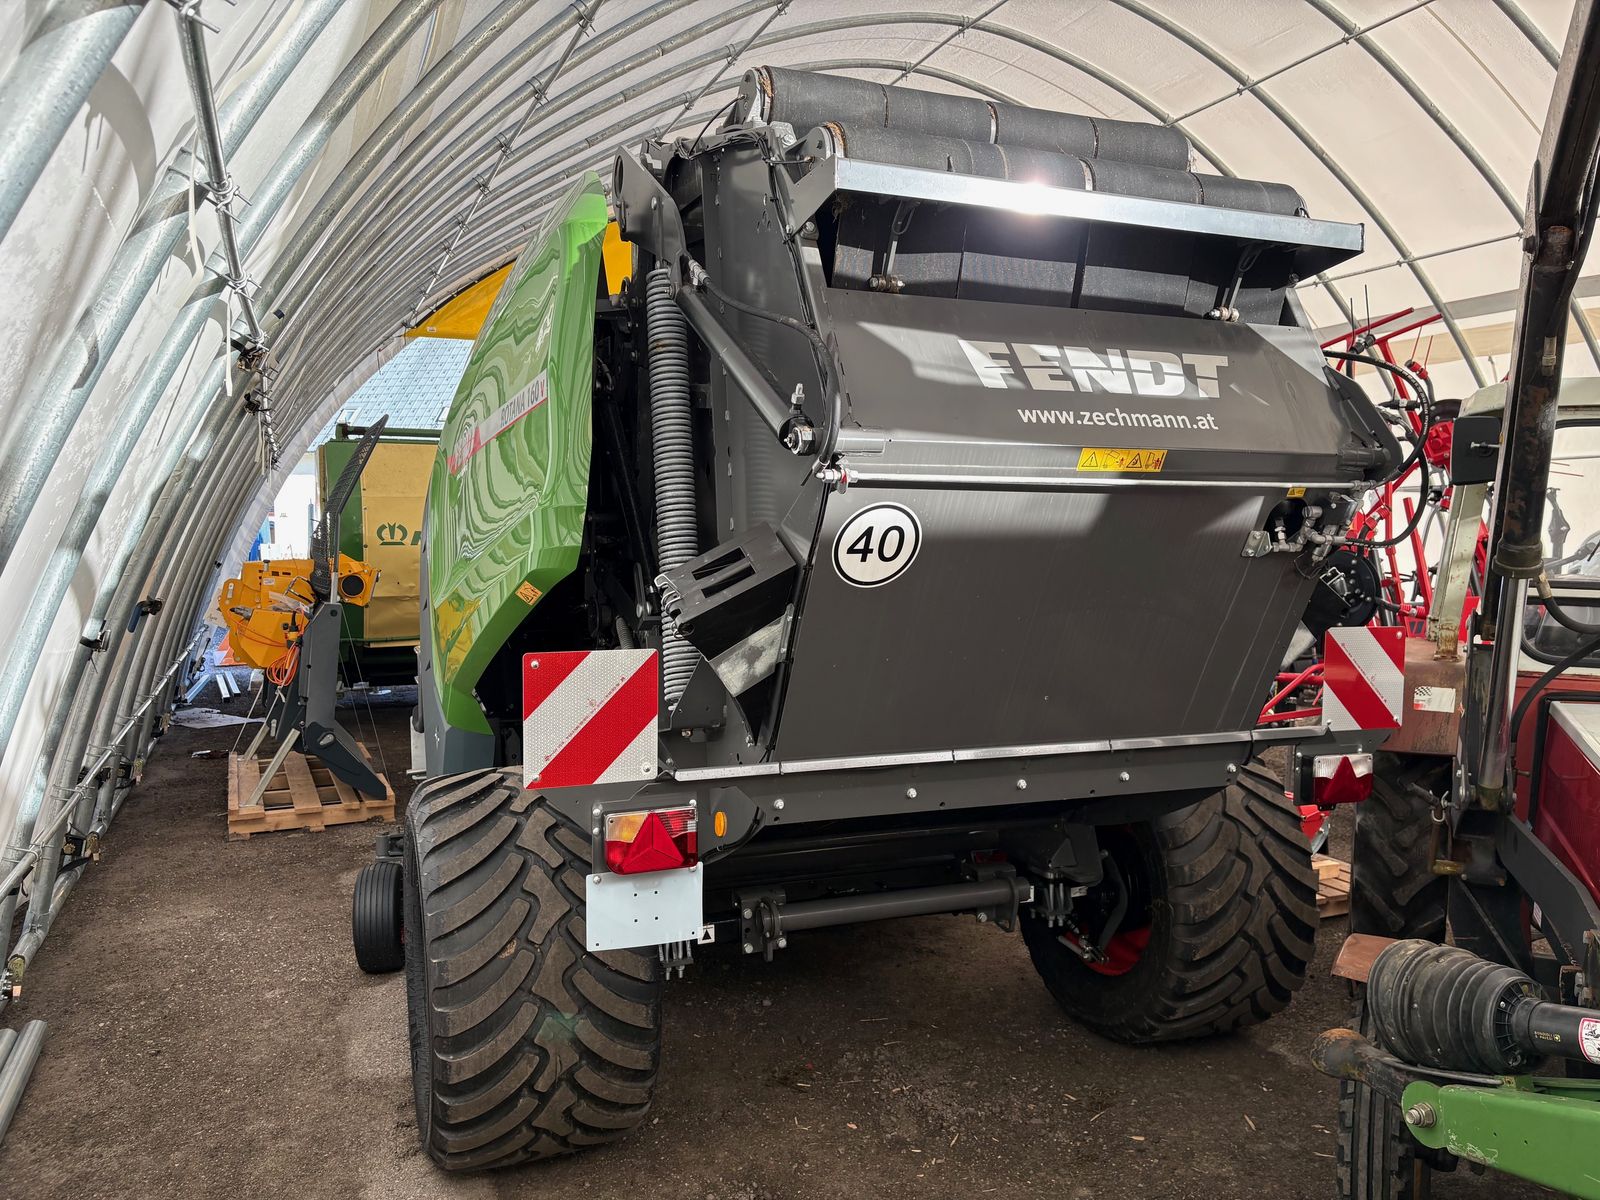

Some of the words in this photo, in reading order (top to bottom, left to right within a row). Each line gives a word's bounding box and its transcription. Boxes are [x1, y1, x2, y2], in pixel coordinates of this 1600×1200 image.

[957, 339, 1229, 399] FENDT
[499, 391, 526, 429] ROTANA
[1017, 406, 1220, 431] www.zechmann.at
[846, 525, 905, 563] 40
